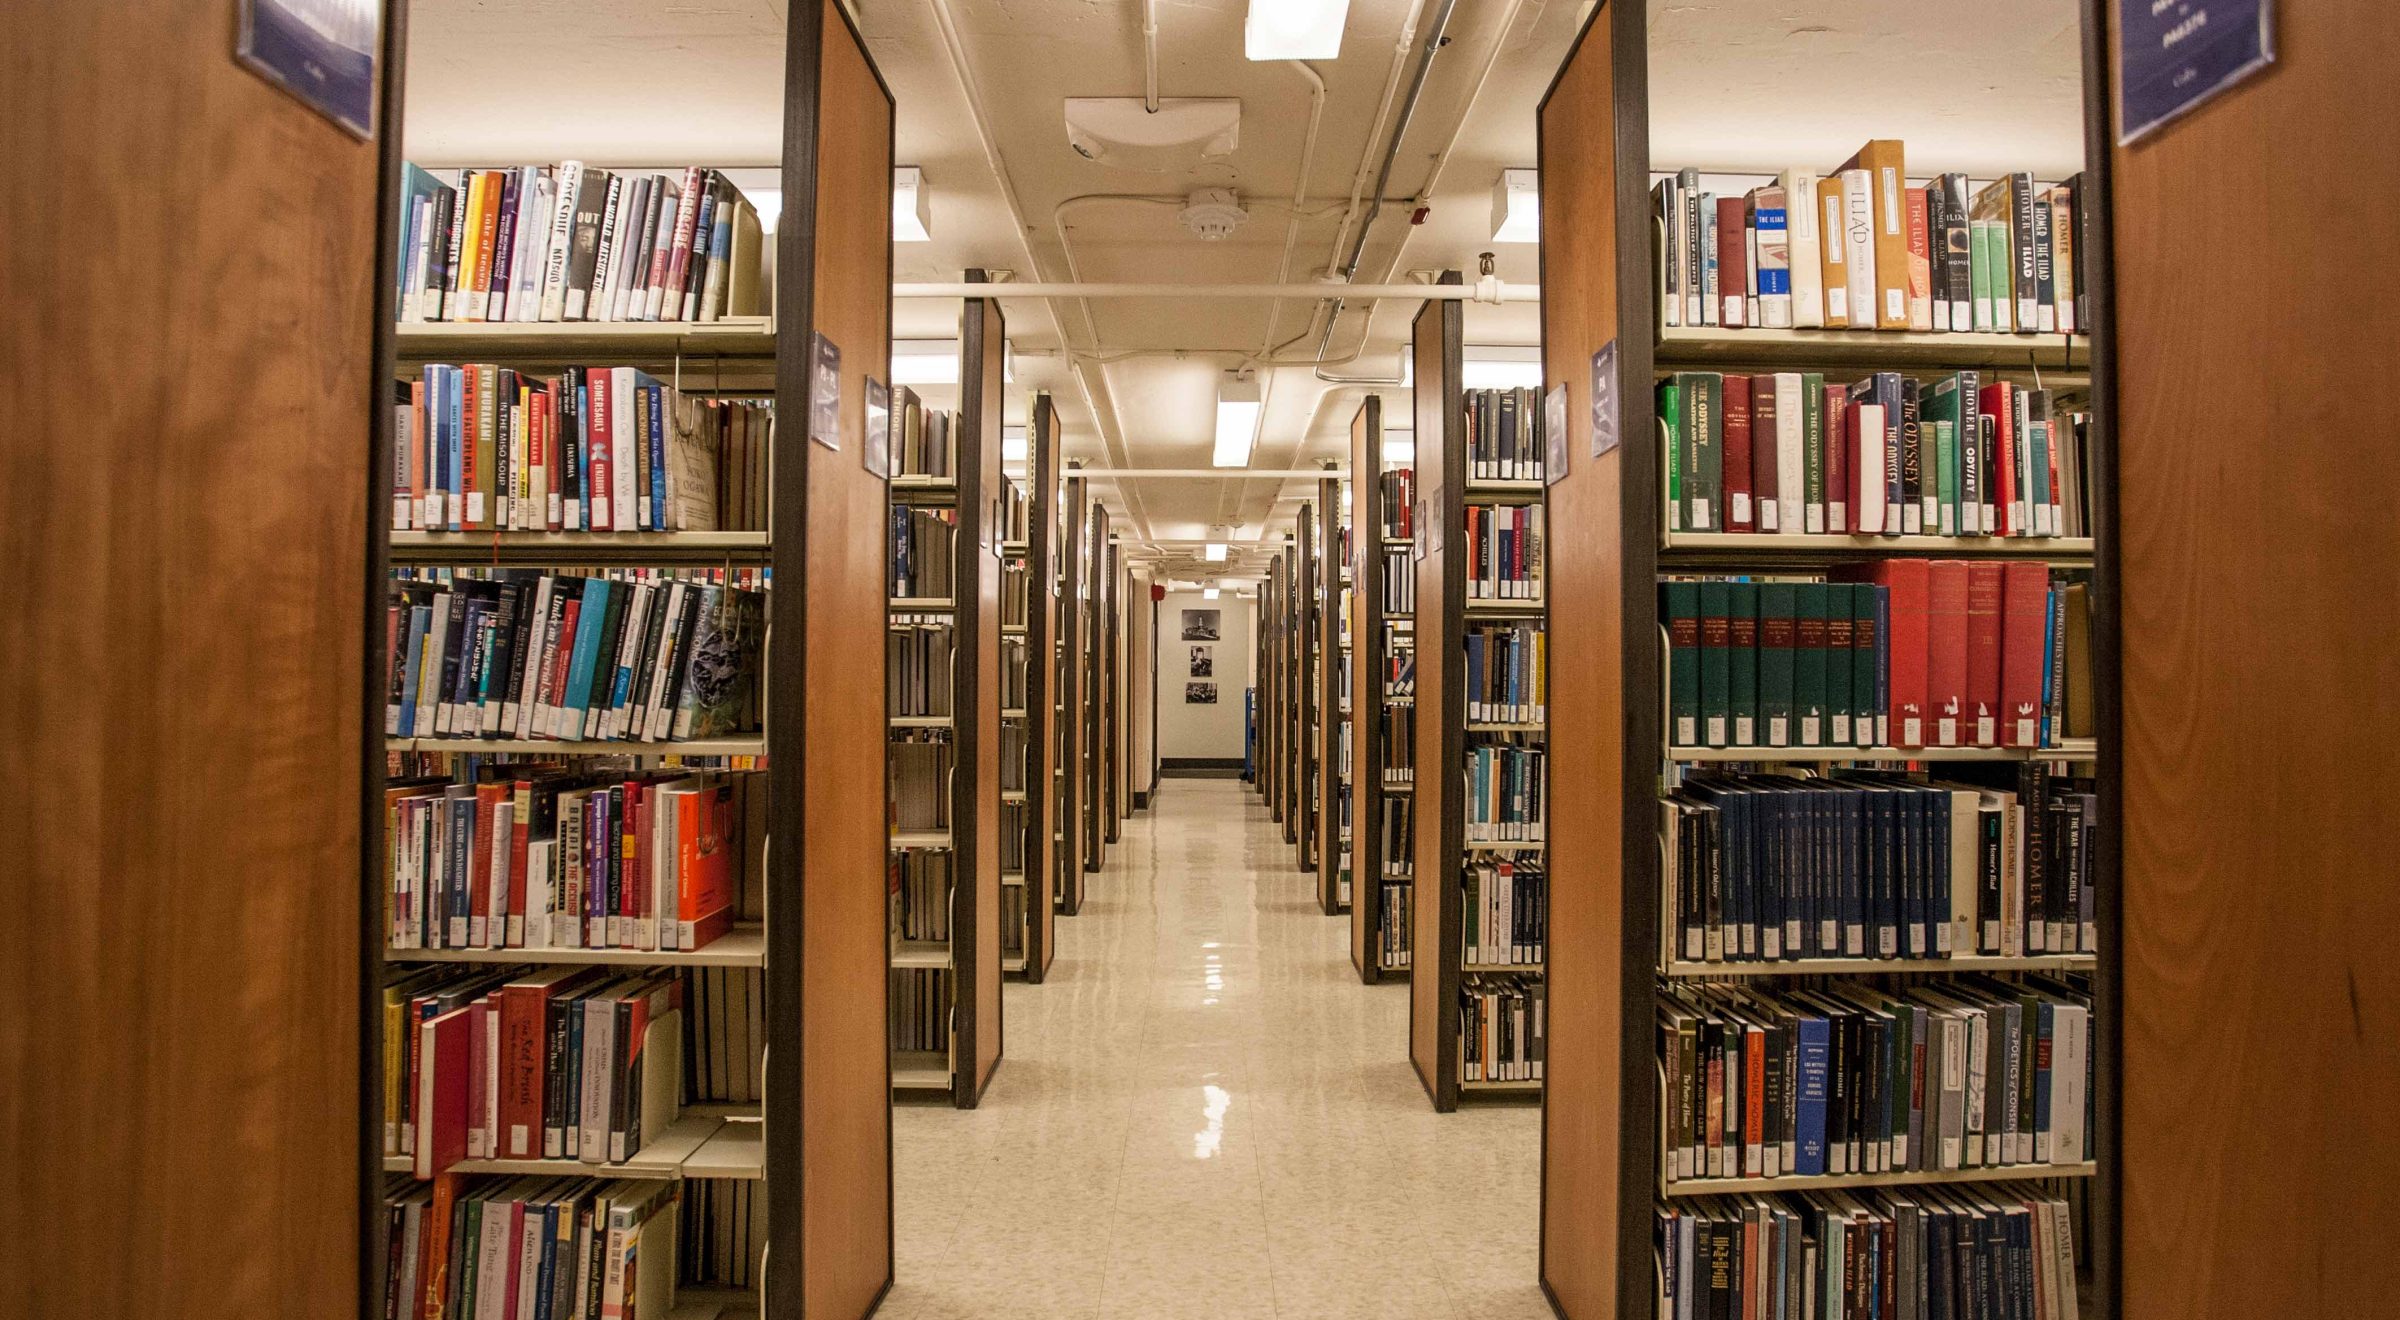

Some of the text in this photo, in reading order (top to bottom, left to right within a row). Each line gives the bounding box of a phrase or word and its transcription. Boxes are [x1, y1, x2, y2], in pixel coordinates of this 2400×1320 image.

[482, 213, 493, 251] Lake of
[577, 211, 601, 225] OUT
[595, 177, 621, 276] REAL WORLD NATSUO
[1758, 215, 1785, 223] THE ILIAD
[1849, 192, 1869, 244] ILIAD
[1911, 204, 1922, 225] THE
[1937, 202, 1946, 260] HOMER ILIAD
[2020, 189, 2033, 278] HOMER ILIAD
[2059, 214, 2068, 254] HOMER
[692, 228, 709, 255] FAMILY
[1912, 227, 1923, 254] ILIAD
[2035, 208, 2050, 280] HOMER THE ILIAD
[549, 248, 564, 283] NATSUO
[464, 397, 473, 413] THE
[480, 370, 493, 441] RYU MURAKAMI
[639, 400, 648, 440] PERSONAL
[892, 388, 902, 433] IN THEORY
[1698, 381, 1708, 447] THE ODYSSEY
[498, 402, 508, 486] IN THE MISO SOUP
[594, 379, 605, 492] SOMERSAULT KENZABURO
[640, 442, 649, 474] MATTER
[1810, 411, 1819, 482] THE ODYSSEY OF
[1886, 426, 1898, 484] THE ODYSSEY
[1904, 400, 1918, 485] The ODYSSEY
[1965, 390, 1975, 492] HOMER ODYSSEY
[548, 628, 557, 641] an
[689, 590, 711, 661] ECHOING SONG
[541, 642, 556, 685] Imperial
[2052, 602, 2065, 707] APPROACHES TO HOMER
[456, 817, 465, 827] THE
[568, 807, 579, 881] BANDI THE
[612, 820, 621, 847] Teaching
[2030, 766, 2042, 906] THE AGES OF HOMER
[611, 858, 620, 885] Learning
[1989, 843, 1997, 890] Homer's Iliad
[2068, 817, 2080, 902] THE WAR ACHILLES
[611, 885, 619, 910] Chinese
[1711, 874, 1719, 898] Odyssey
[2010, 1026, 2018, 1039] The
[1683, 1074, 1691, 1085] The
[1750, 1053, 1760, 1100] HOMERIC
[2009, 1040, 2018, 1079] POETICS
[2058, 1214, 2071, 1261] HOMER
[588, 1239, 603, 1316] Plum and Bamboo
